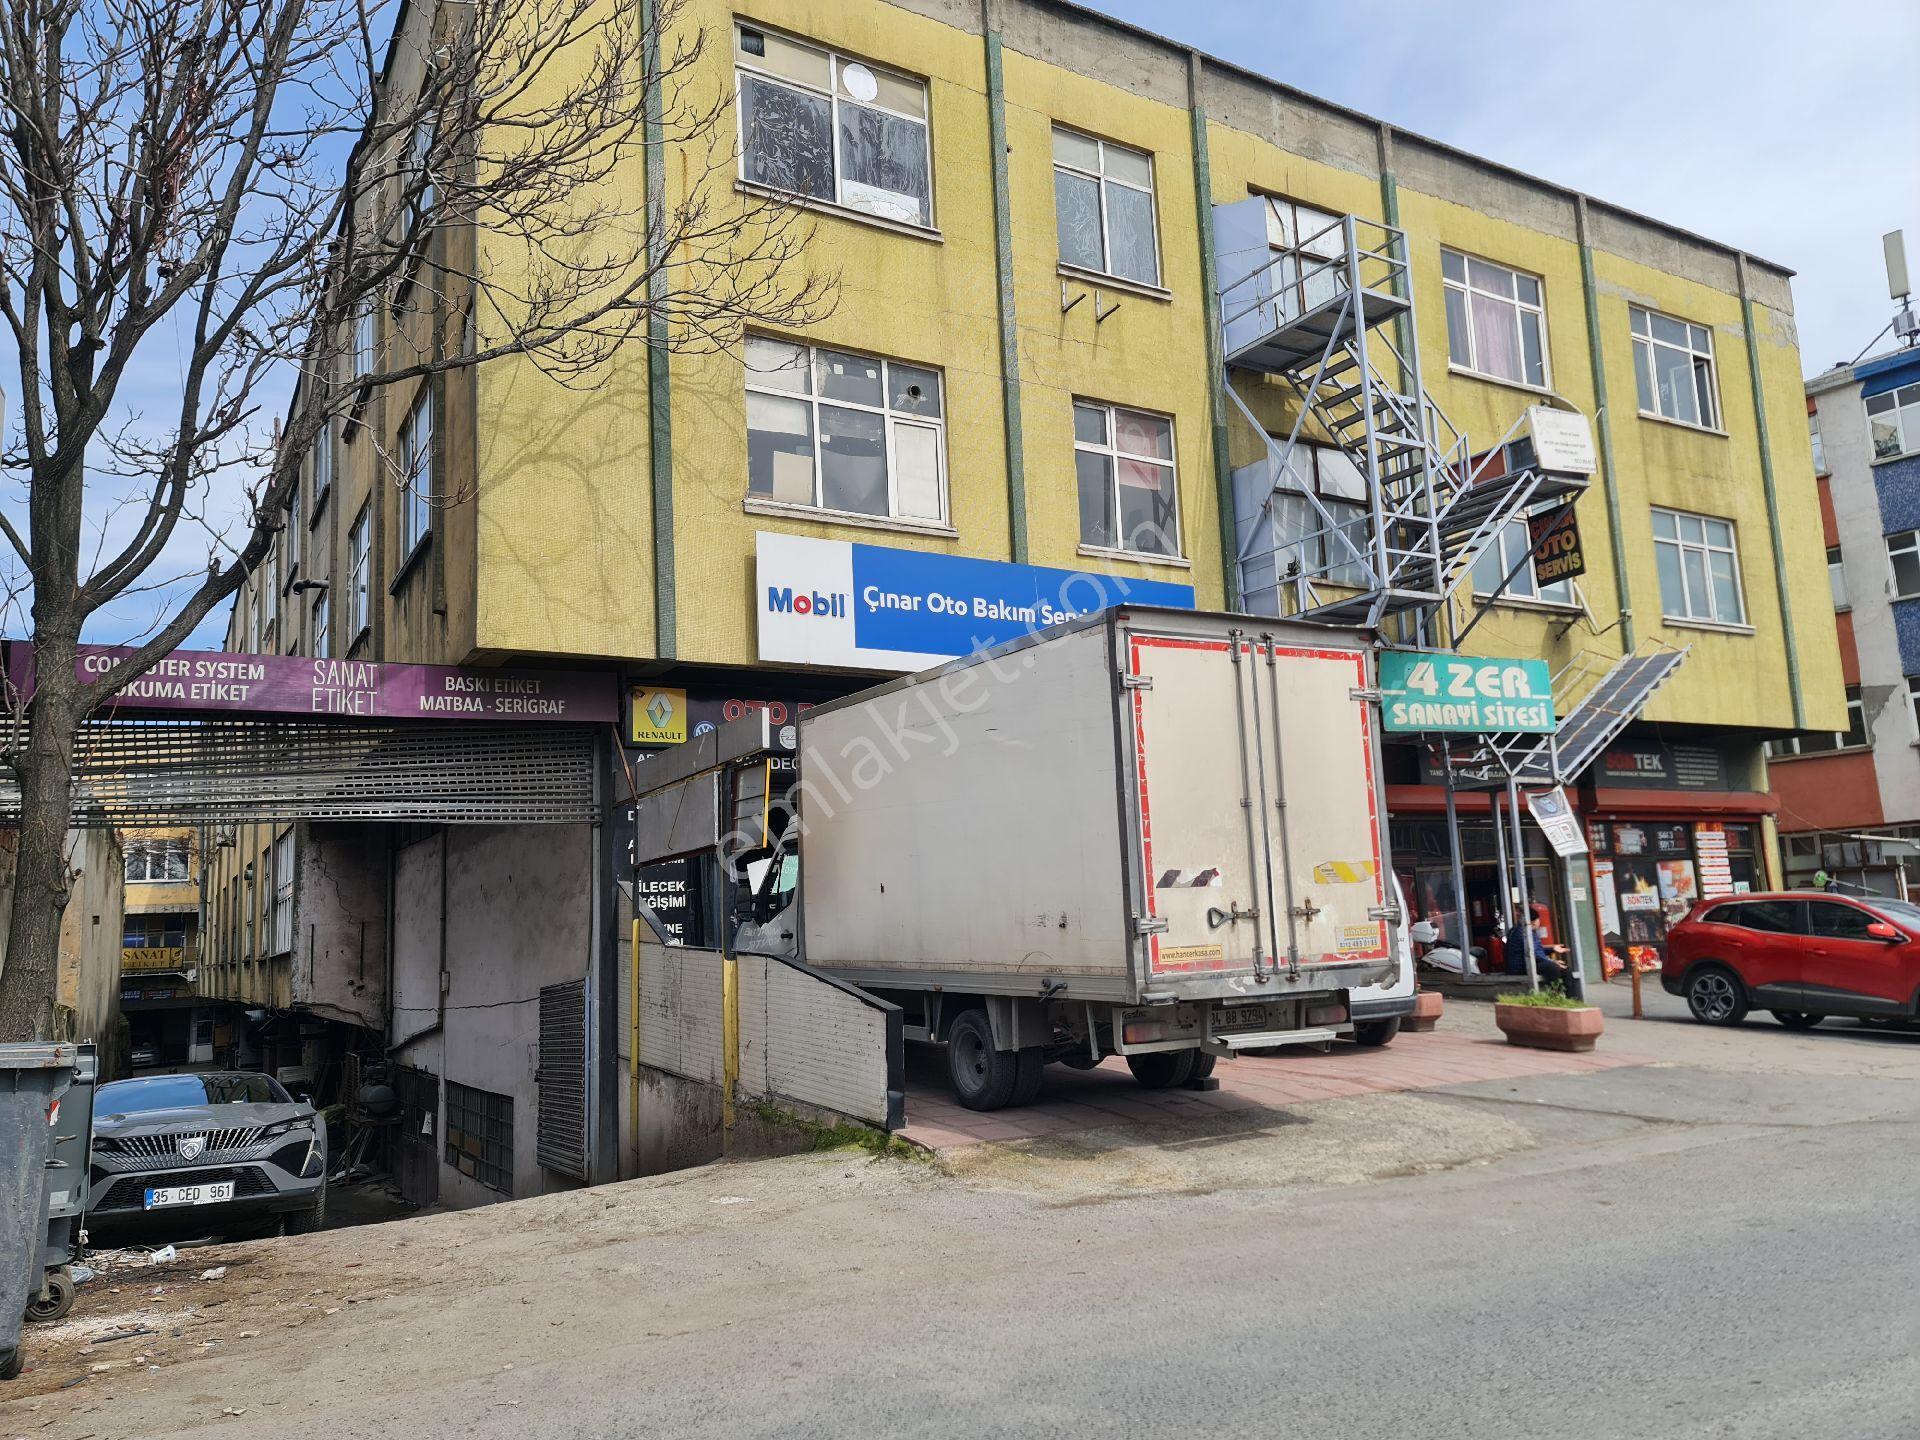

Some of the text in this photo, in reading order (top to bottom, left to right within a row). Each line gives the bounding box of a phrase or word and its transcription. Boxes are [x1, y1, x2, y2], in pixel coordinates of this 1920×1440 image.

[768, 586, 845, 618] Mobil
[863, 585, 1088, 625] Çınar Oto Bakım Ser
[84, 655, 265, 680] COTER SYSTEM
[313, 660, 378, 688] SANAT
[113, 680, 250, 701] KUMA ETİKET
[445, 676, 542, 694] BASKI ETİKET
[1406, 661, 1531, 699] 4 ZER
[312, 688, 378, 715] ETİKET
[420, 695, 483, 713] MATBAA
[495, 696, 566, 714] SERİGRAF
[1392, 701, 1549, 727] SANAYİ SİTESİ
[638, 731, 683, 740] RENAULT
[638, 879, 686, 894] İLECEK
[123, 950, 167, 961] SANAT
[153, 1184, 231, 1203] 35 CED 961
